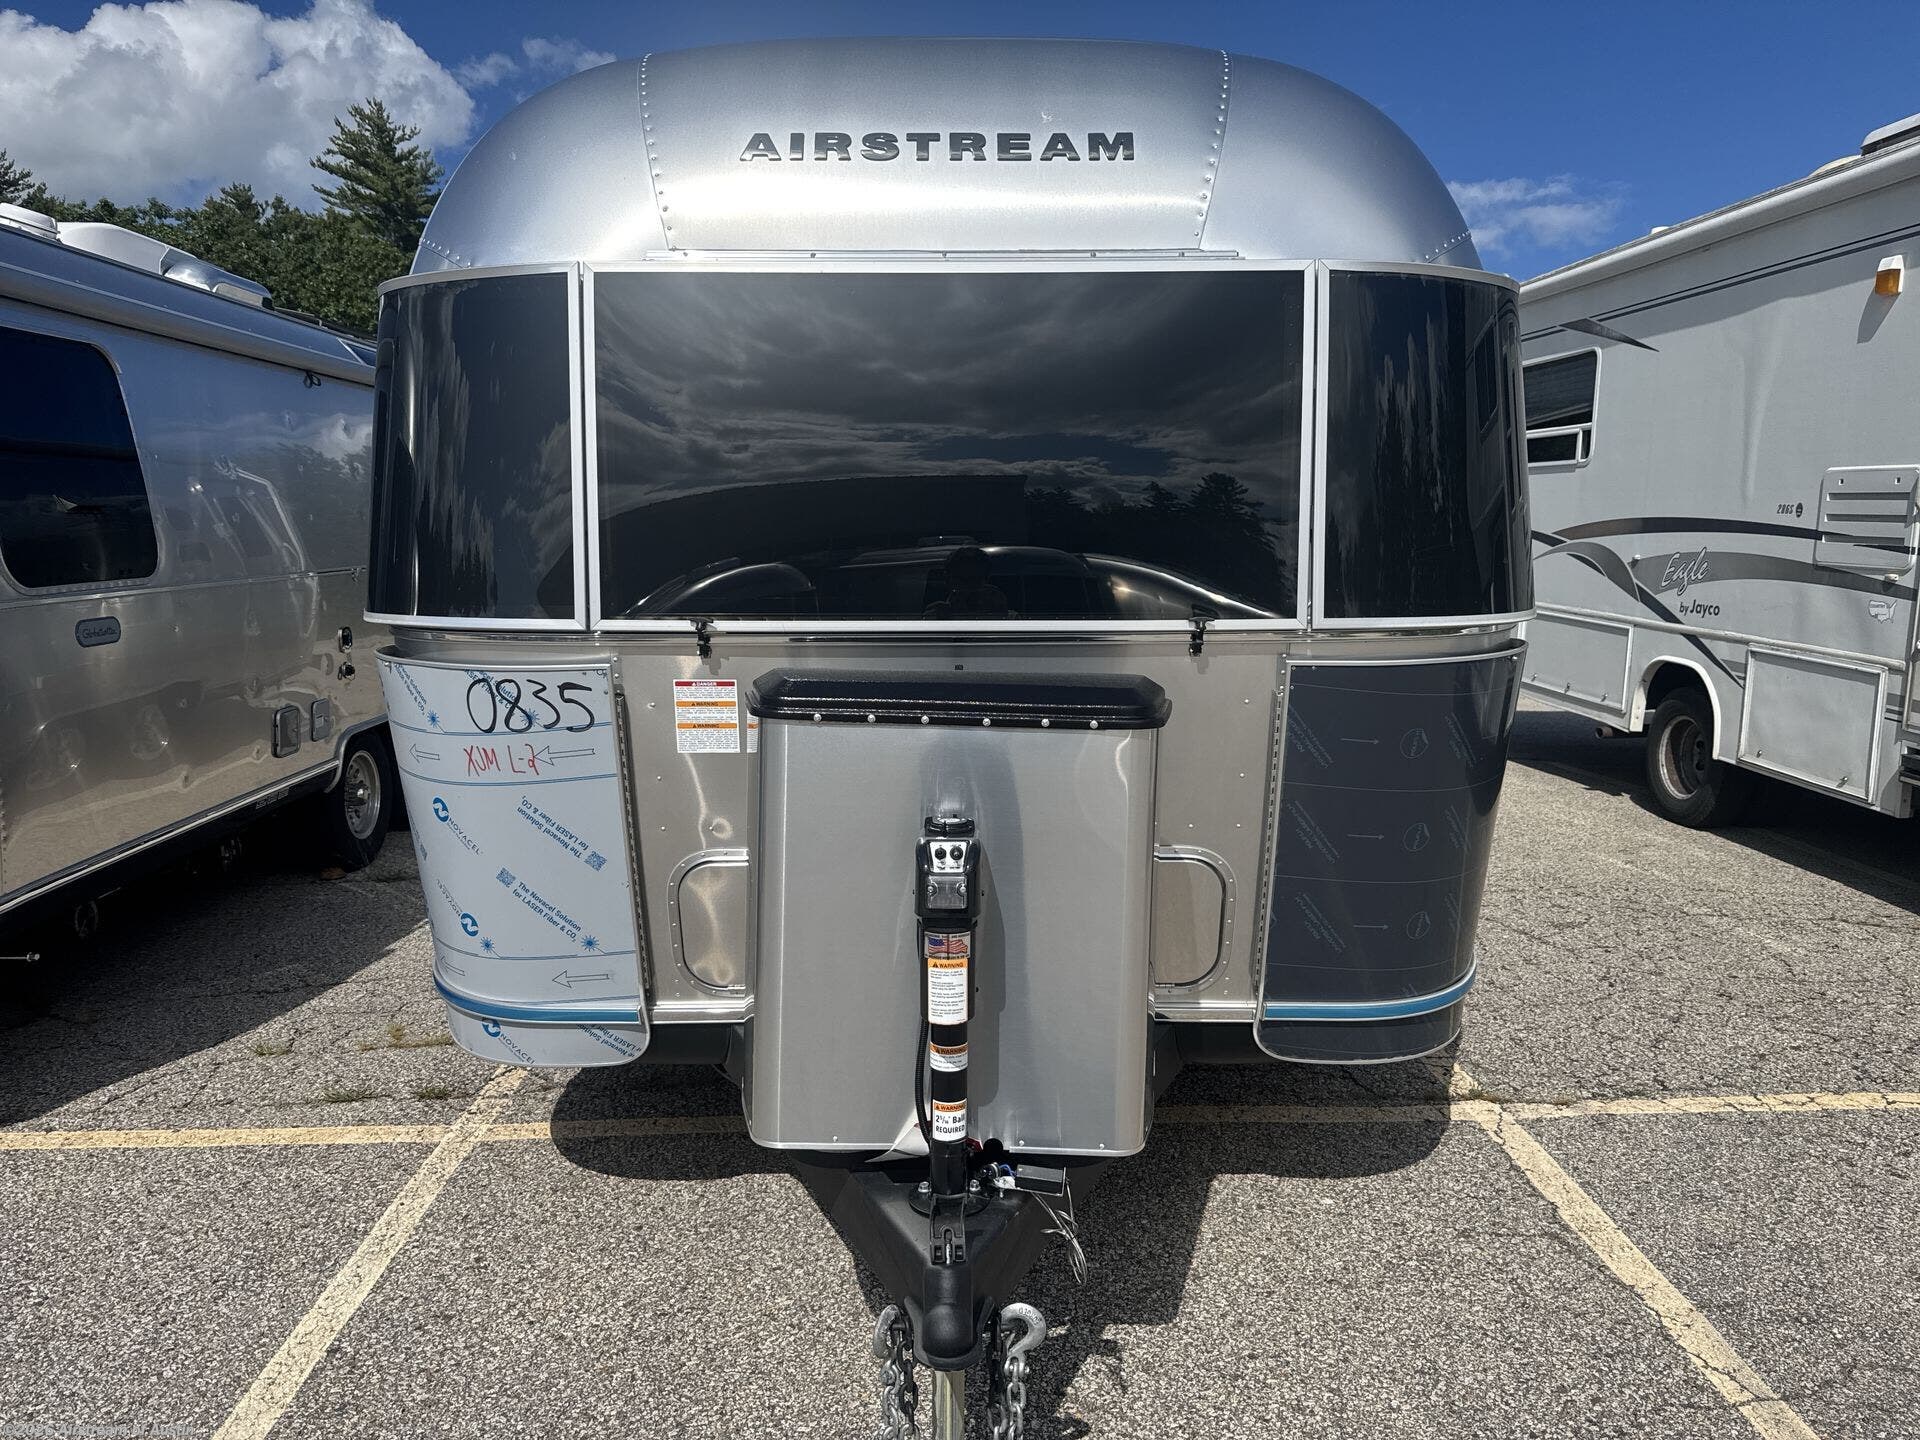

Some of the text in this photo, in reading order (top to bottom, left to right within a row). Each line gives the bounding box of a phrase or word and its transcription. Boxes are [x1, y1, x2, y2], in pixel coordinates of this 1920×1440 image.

[739, 132, 1135, 162] AIRSTREAM
[1661, 546, 1711, 596] Eagle
[1679, 599, 1721, 618] by Jayco
[466, 678, 595, 734] 0835
[517, 806, 583, 858] The Novacel Solution
[539, 812, 557, 828] Fiber
[555, 824, 578, 844] LASER
[449, 817, 480, 855] NOVACEL
[578, 840, 589, 851] for
[512, 888, 522, 899] for
[521, 896, 544, 915] LASER
[542, 912, 561, 928] Fiber
[518, 881, 581, 932] The Novacel Solution
[600, 1038, 628, 1056] Novacel
[935, 1125, 965, 1134] REQUIRED
